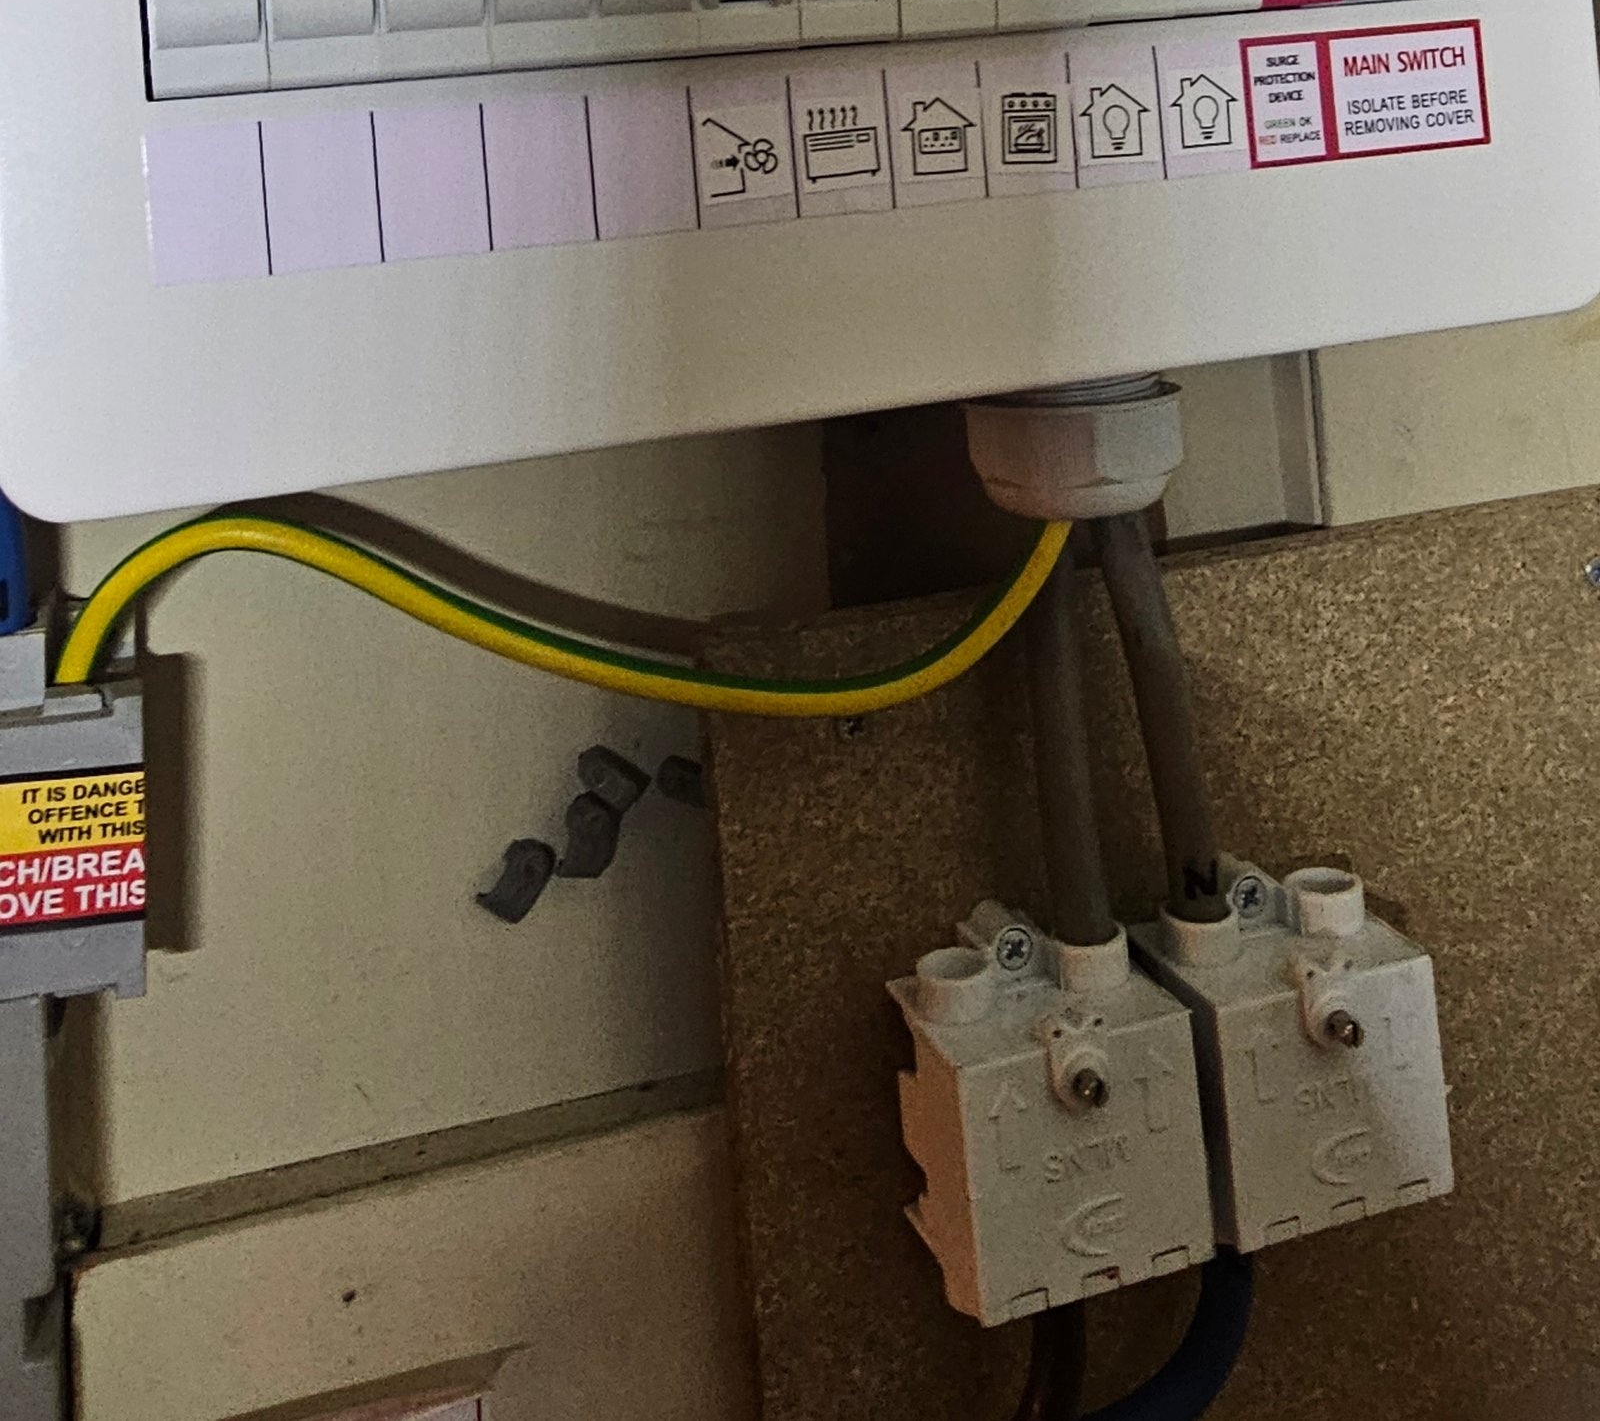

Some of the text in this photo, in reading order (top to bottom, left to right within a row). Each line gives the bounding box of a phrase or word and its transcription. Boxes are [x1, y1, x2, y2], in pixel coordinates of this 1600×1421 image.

[1266, 54, 1300, 68] SURGE
[1343, 46, 1465, 77] MAIN SWITCH
[1254, 71, 1315, 86] PROTECTION
[1268, 90, 1304, 103] DEVICE
[1347, 89, 1468, 115] ISOLATE BEFORE
[1264, 116, 1312, 129] GREEN OK
[1345, 109, 1475, 136] REMOVING COVER
[1258, 131, 1321, 146] RED REPLACE
[21, 787, 41, 804] IT
[47, 786, 66, 802] IS
[28, 800, 128, 824] OFFENCE
[38, 820, 146, 844] WITH THIS
[0, 848, 145, 887] CH/BREA
[73, 879, 146, 911] THIS
